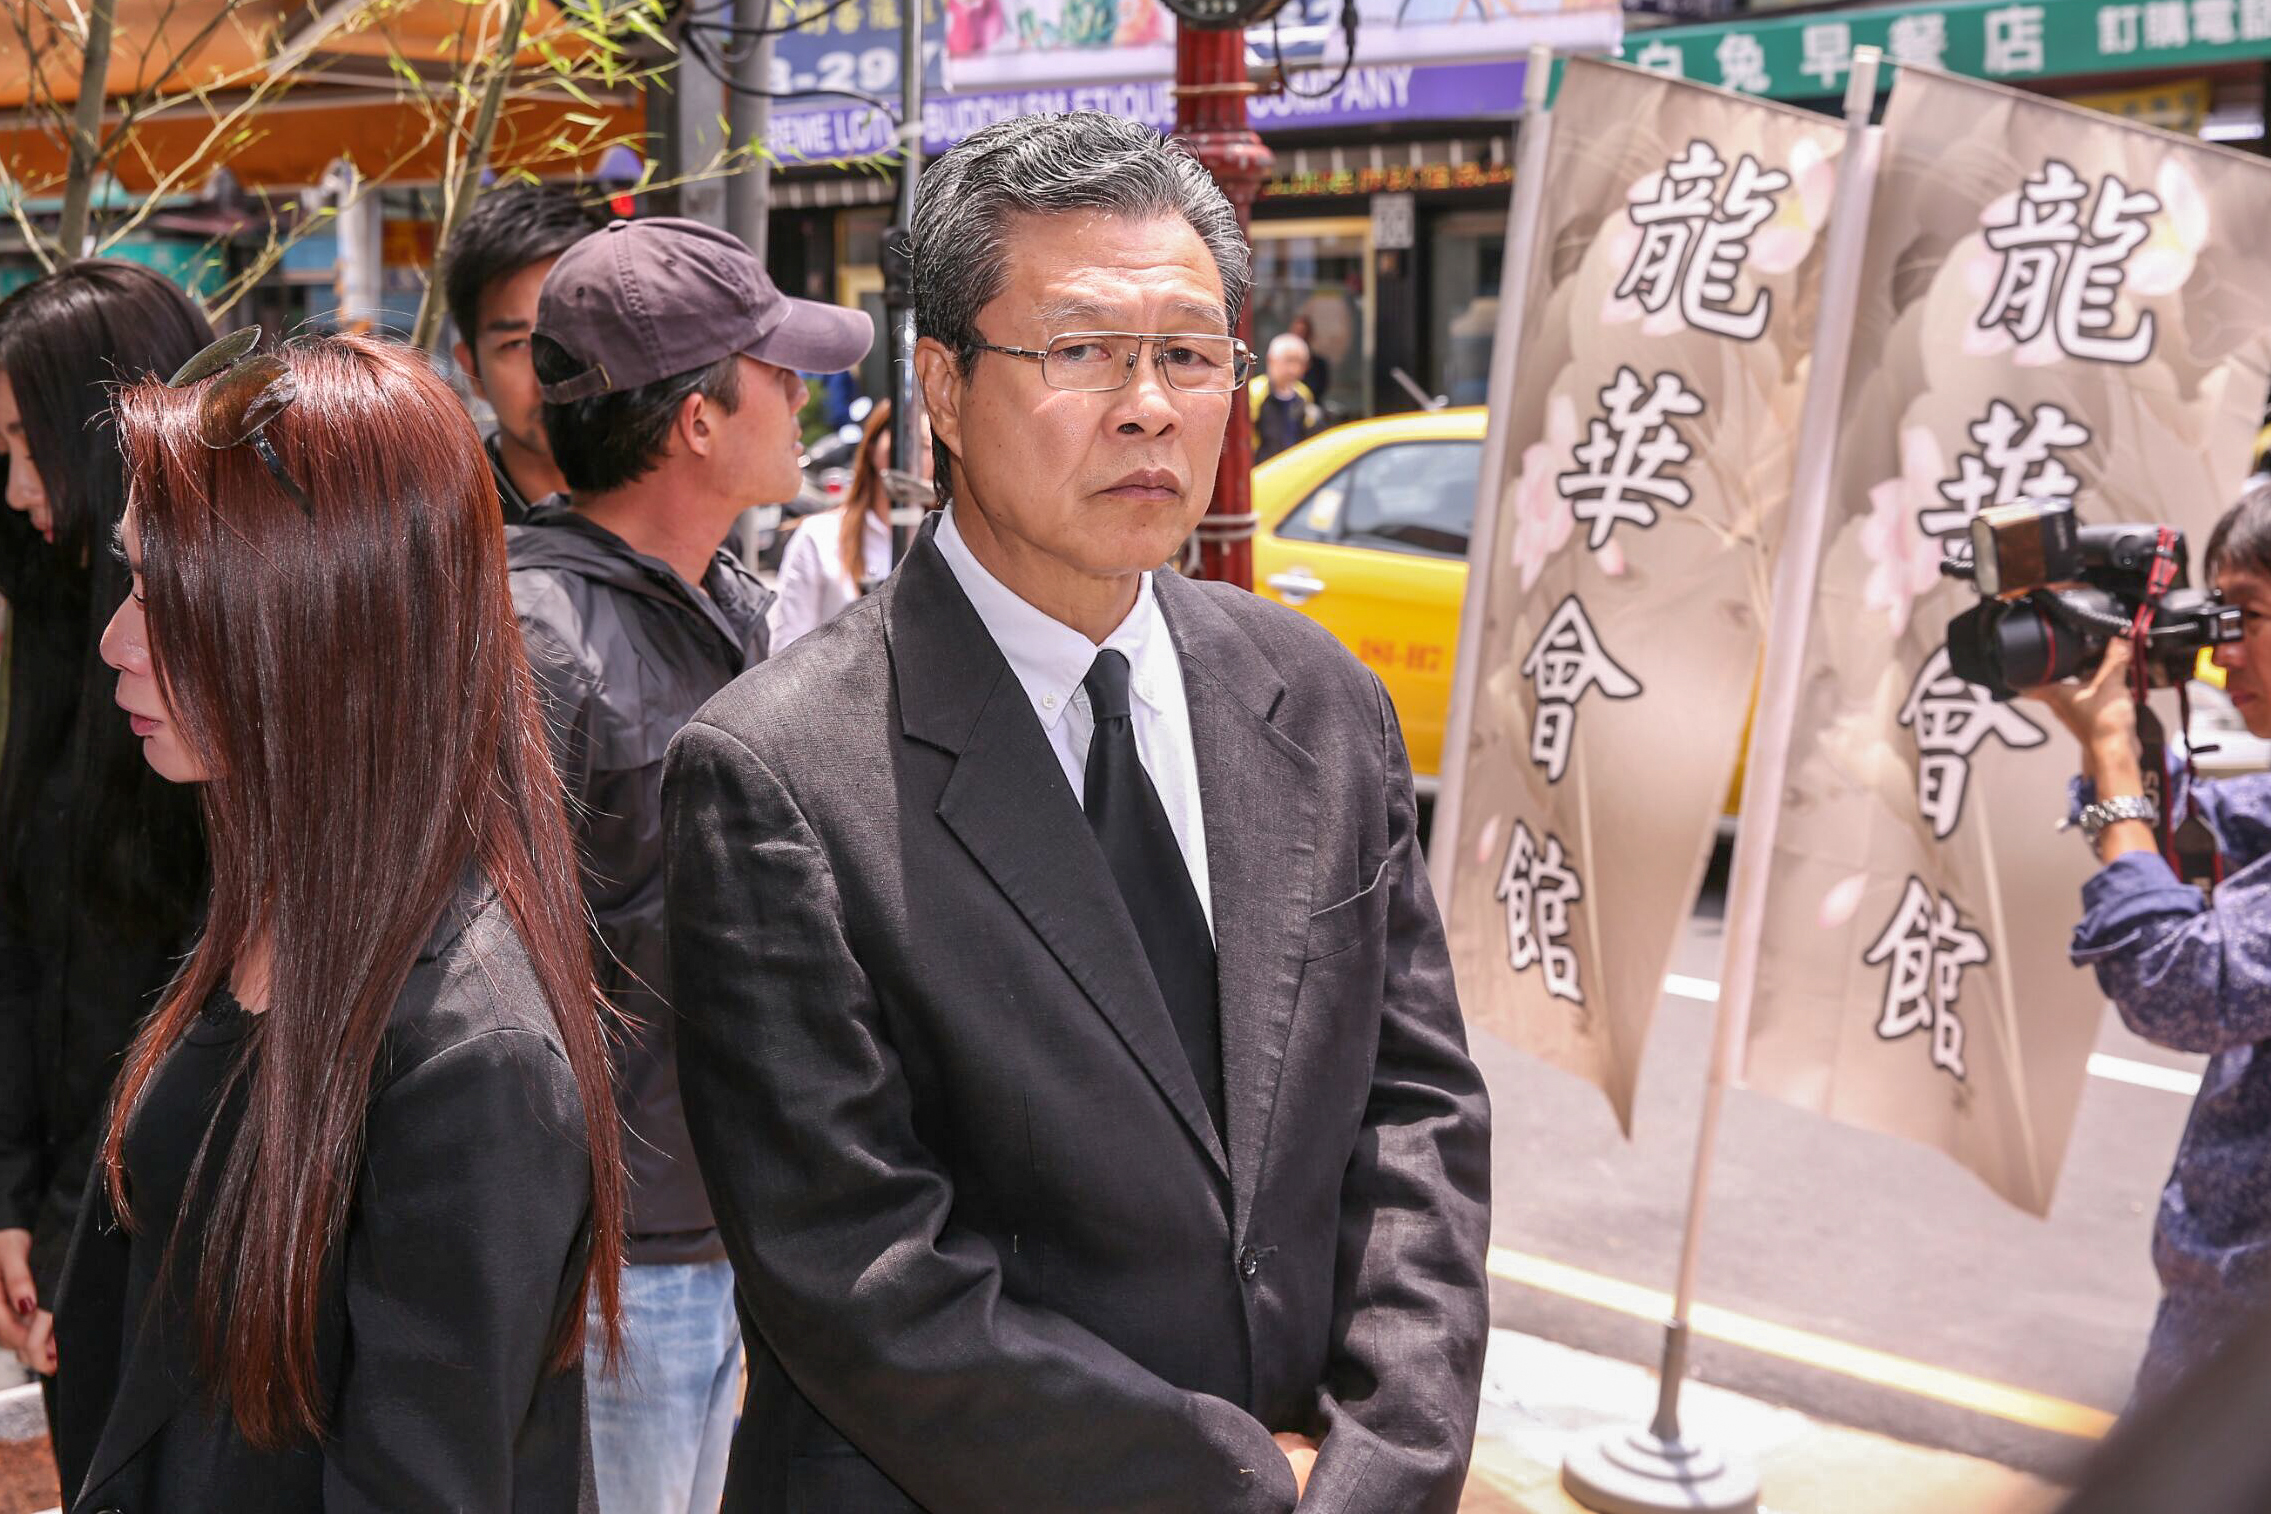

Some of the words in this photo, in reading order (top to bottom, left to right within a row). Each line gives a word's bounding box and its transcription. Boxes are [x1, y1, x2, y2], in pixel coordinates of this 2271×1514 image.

[1636, 8, 2046, 94] 白兔早餐店
[1495, 138, 1792, 1006] 龍華會館
